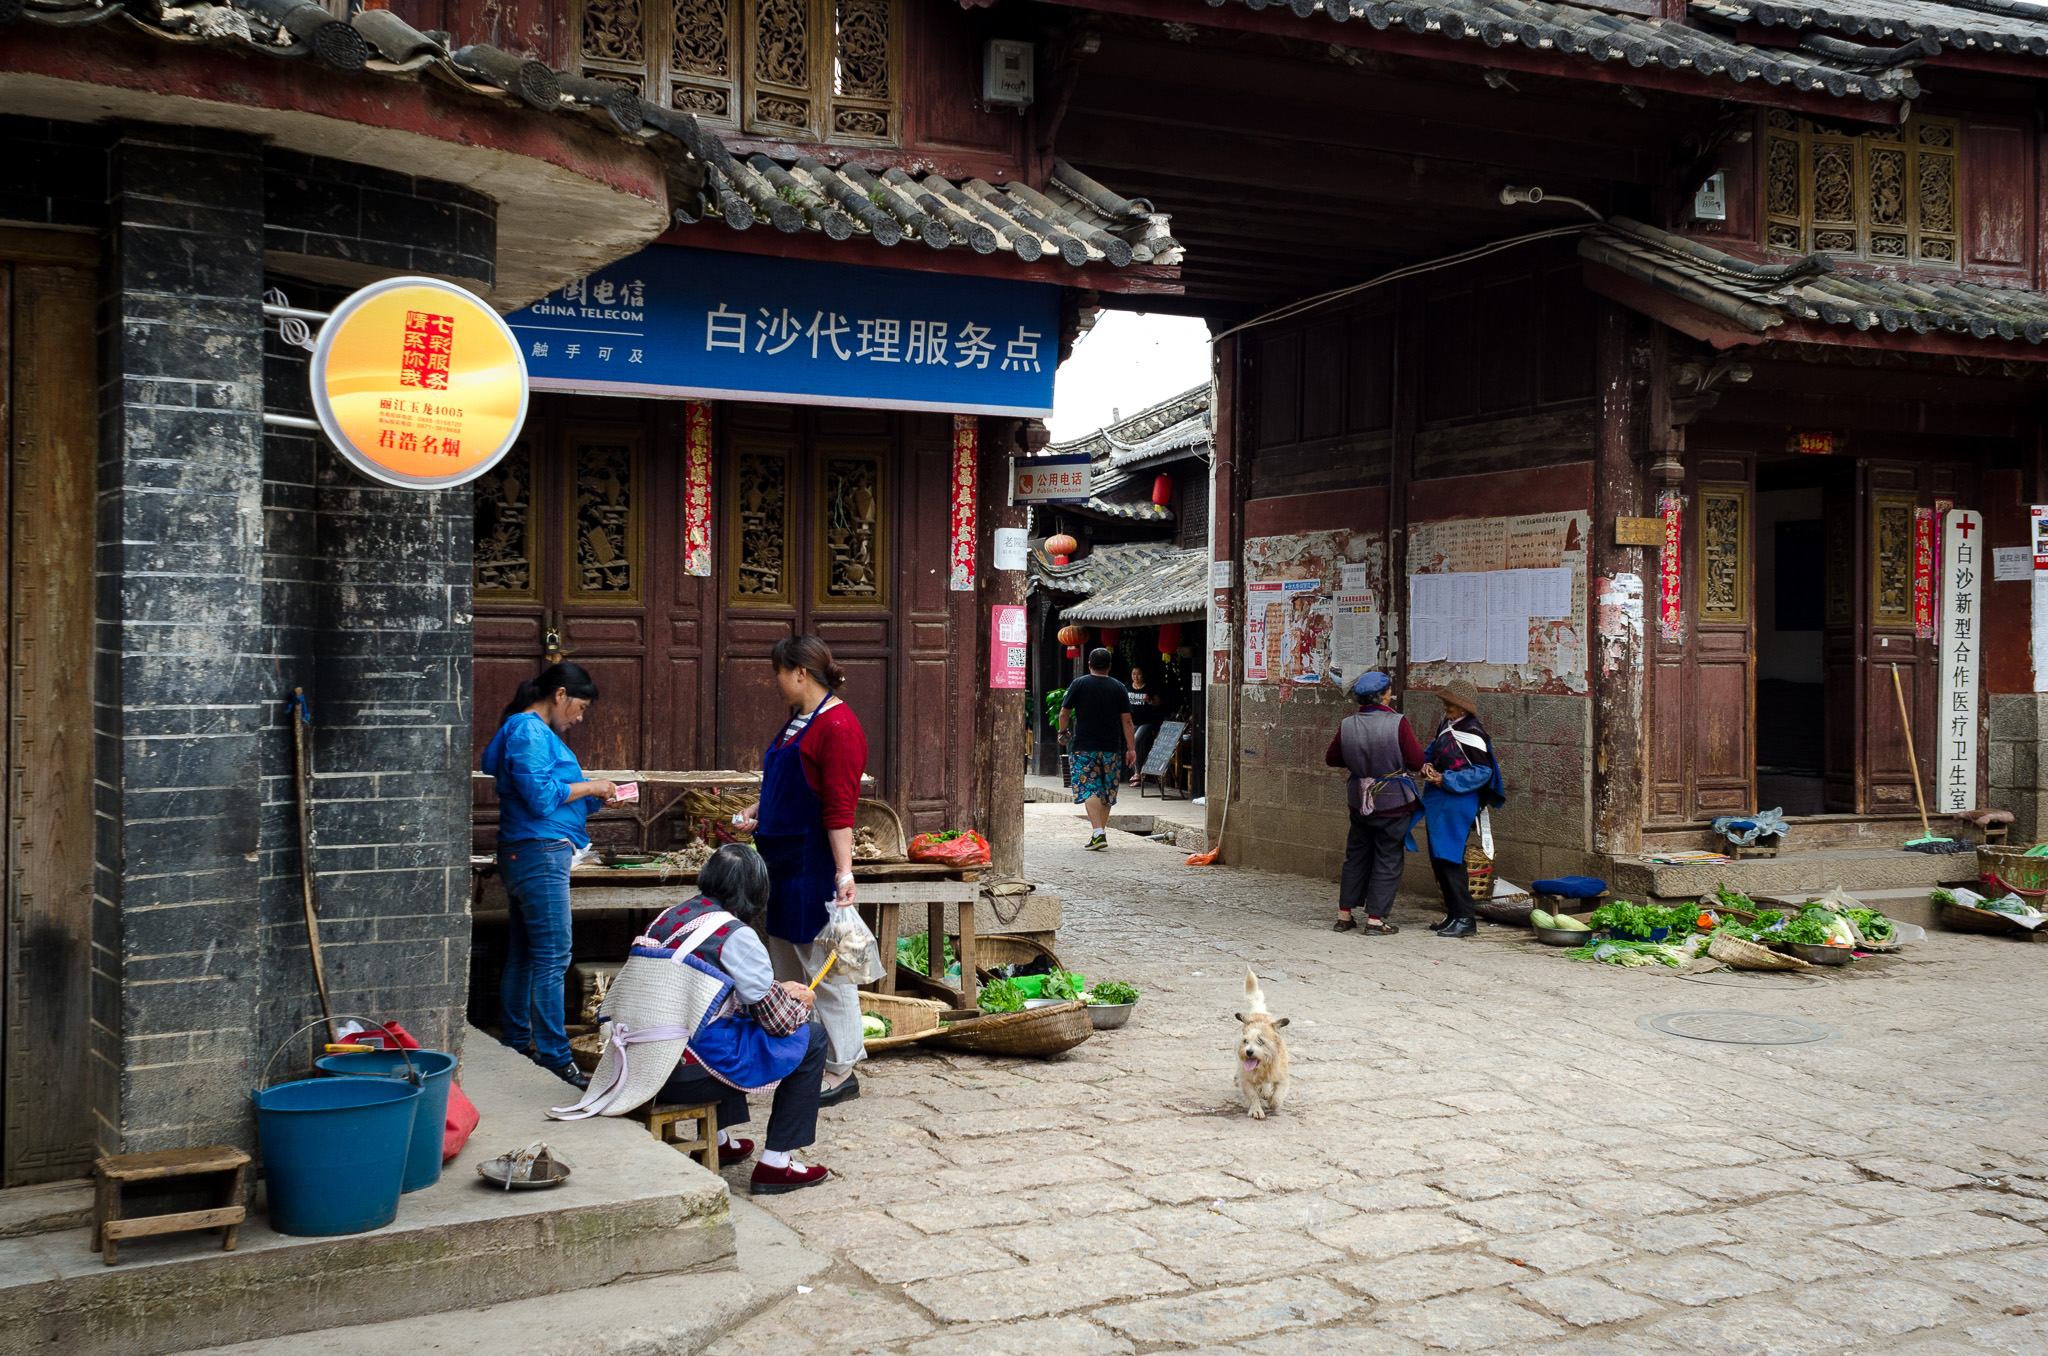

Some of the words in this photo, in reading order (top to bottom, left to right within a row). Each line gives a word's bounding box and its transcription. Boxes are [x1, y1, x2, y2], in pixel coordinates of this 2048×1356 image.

[544, 277, 646, 307] 国电信
[531, 304, 577, 317] CHINA
[580, 307, 644, 322] TELECOM
[401, 312, 430, 388] 情系你我
[425, 316, 454, 390] 七彩服务
[531, 342, 644, 364] 触手可及
[705, 302, 1042, 374] 白沙代理服务点
[379, 397, 464, 418] 丽江玉龙4005
[376, 428, 461, 458] 君浩名烟
[1037, 472, 1083, 487] 公用电话
[1054, 486, 1082, 494] Telephone
[1949, 542, 1973, 811] 白沙新型合作医疗卫生室
